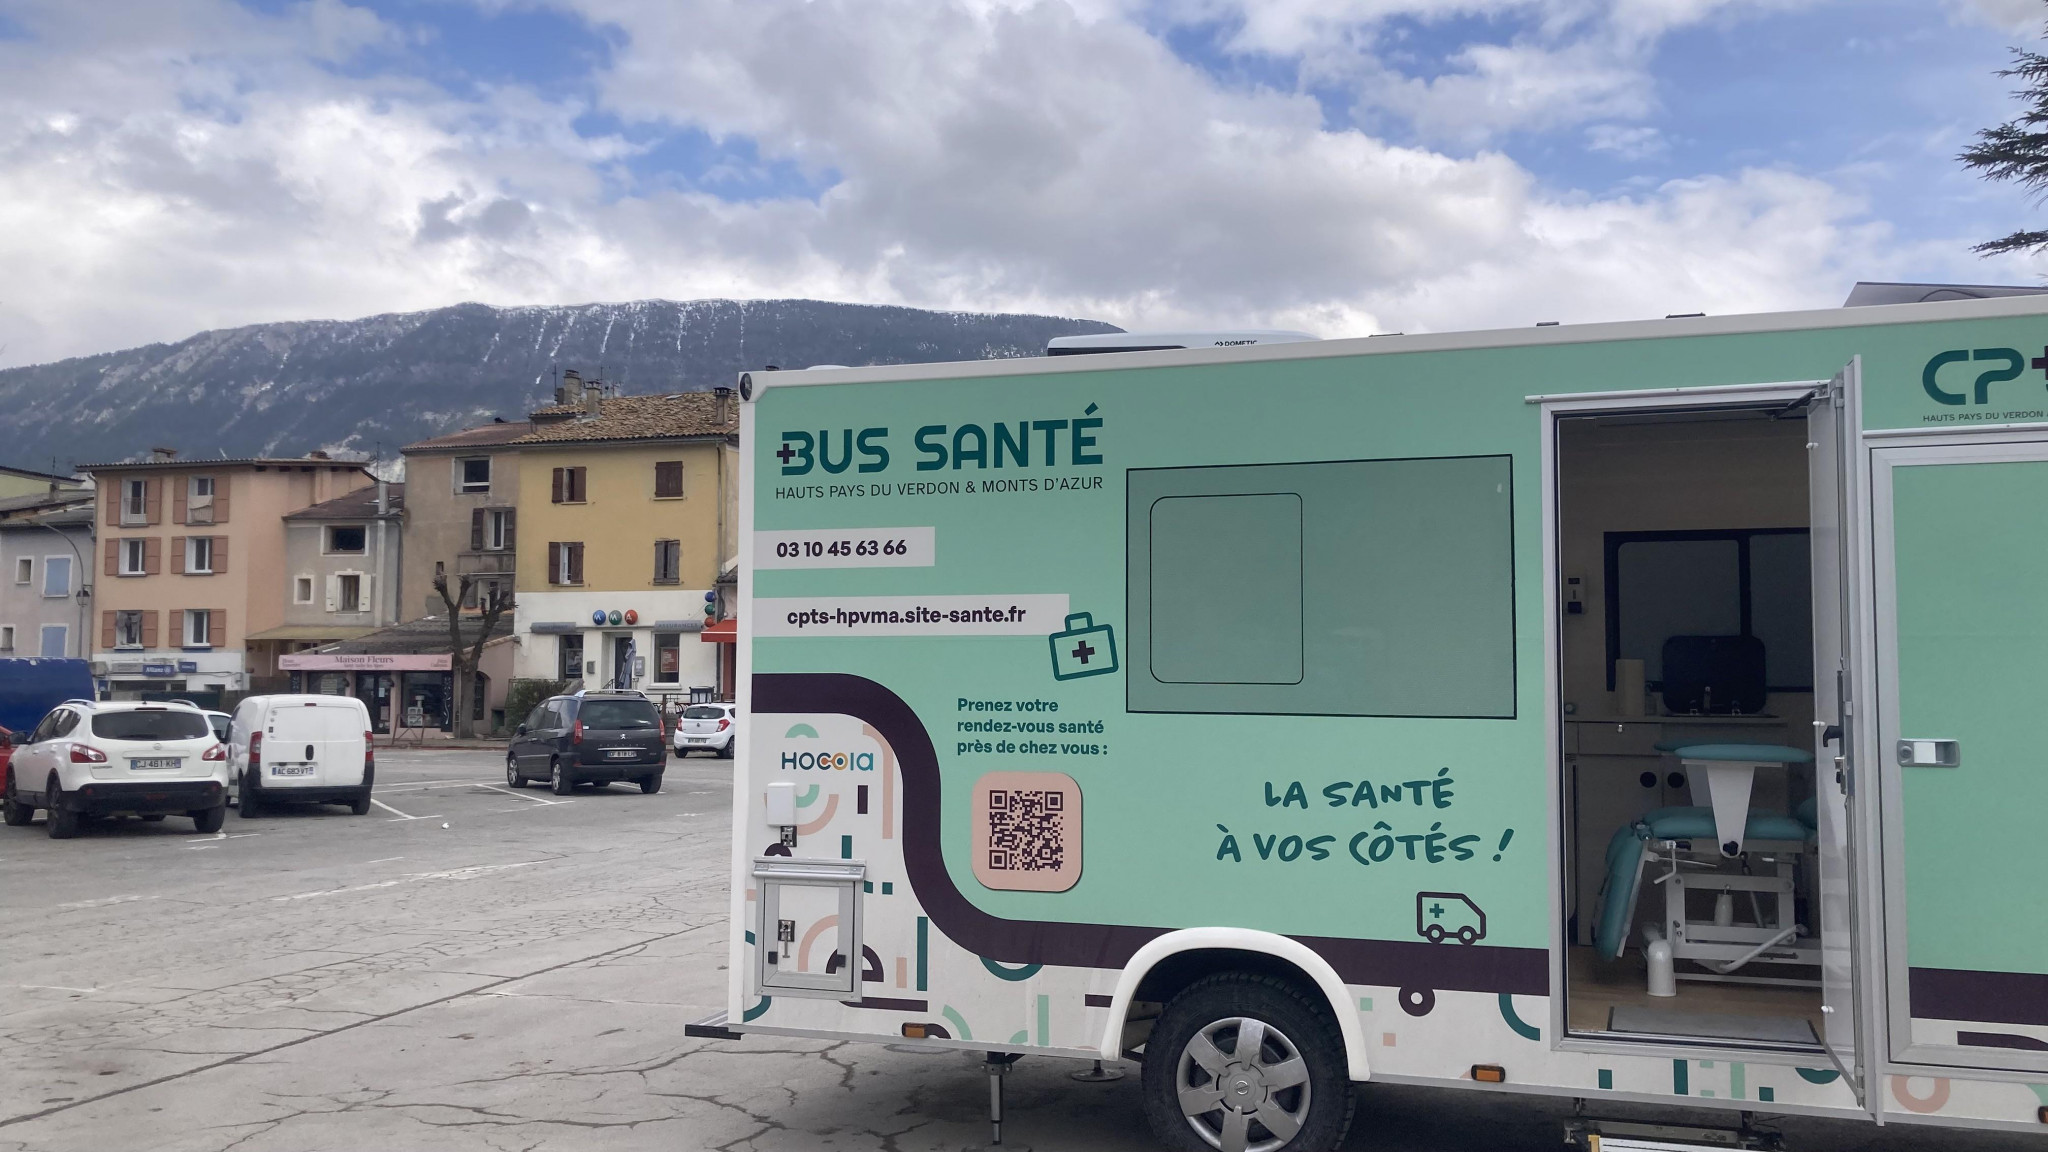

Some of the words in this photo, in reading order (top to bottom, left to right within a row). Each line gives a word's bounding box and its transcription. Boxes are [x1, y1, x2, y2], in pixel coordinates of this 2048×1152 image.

[1922, 414, 1956, 422] HAUTS
[1958, 412, 1983, 421] PAYS
[1985, 412, 2000, 420] DU
[2002, 410, 2044, 419] VERDON
[780, 427, 890, 477] BUS
[914, 402, 1104, 472] SANTÉ
[775, 486, 825, 500] HAUTS
[829, 484, 866, 498] PAYS
[870, 483, 892, 497] DU
[896, 481, 960, 496] VERDON
[965, 480, 977, 494] &
[982, 478, 1039, 494] MONTS
[776, 541, 800, 558] 03
[803, 541, 824, 558] 10
[827, 540, 852, 557] 45
[855, 540, 880, 557] 63
[883, 539, 908, 556] 66
[786, 605, 1027, 629] cpts-hpvma.site-sante.fr
[957, 698, 1013, 712] Prenez
[1016, 699, 1059, 713] votre
[957, 718, 1055, 734] rendez-vous
[1058, 719, 1105, 734] santé
[957, 739, 993, 757] près
[995, 739, 1016, 754] de
[1018, 739, 1058, 755] chez
[1264, 780, 1309, 810] LA
[1322, 766, 1455, 810] SANTÉ
[1216, 823, 1242, 863] À
[1252, 832, 1337, 863] VOS
[1348, 820, 1481, 866] CÔTÉS
